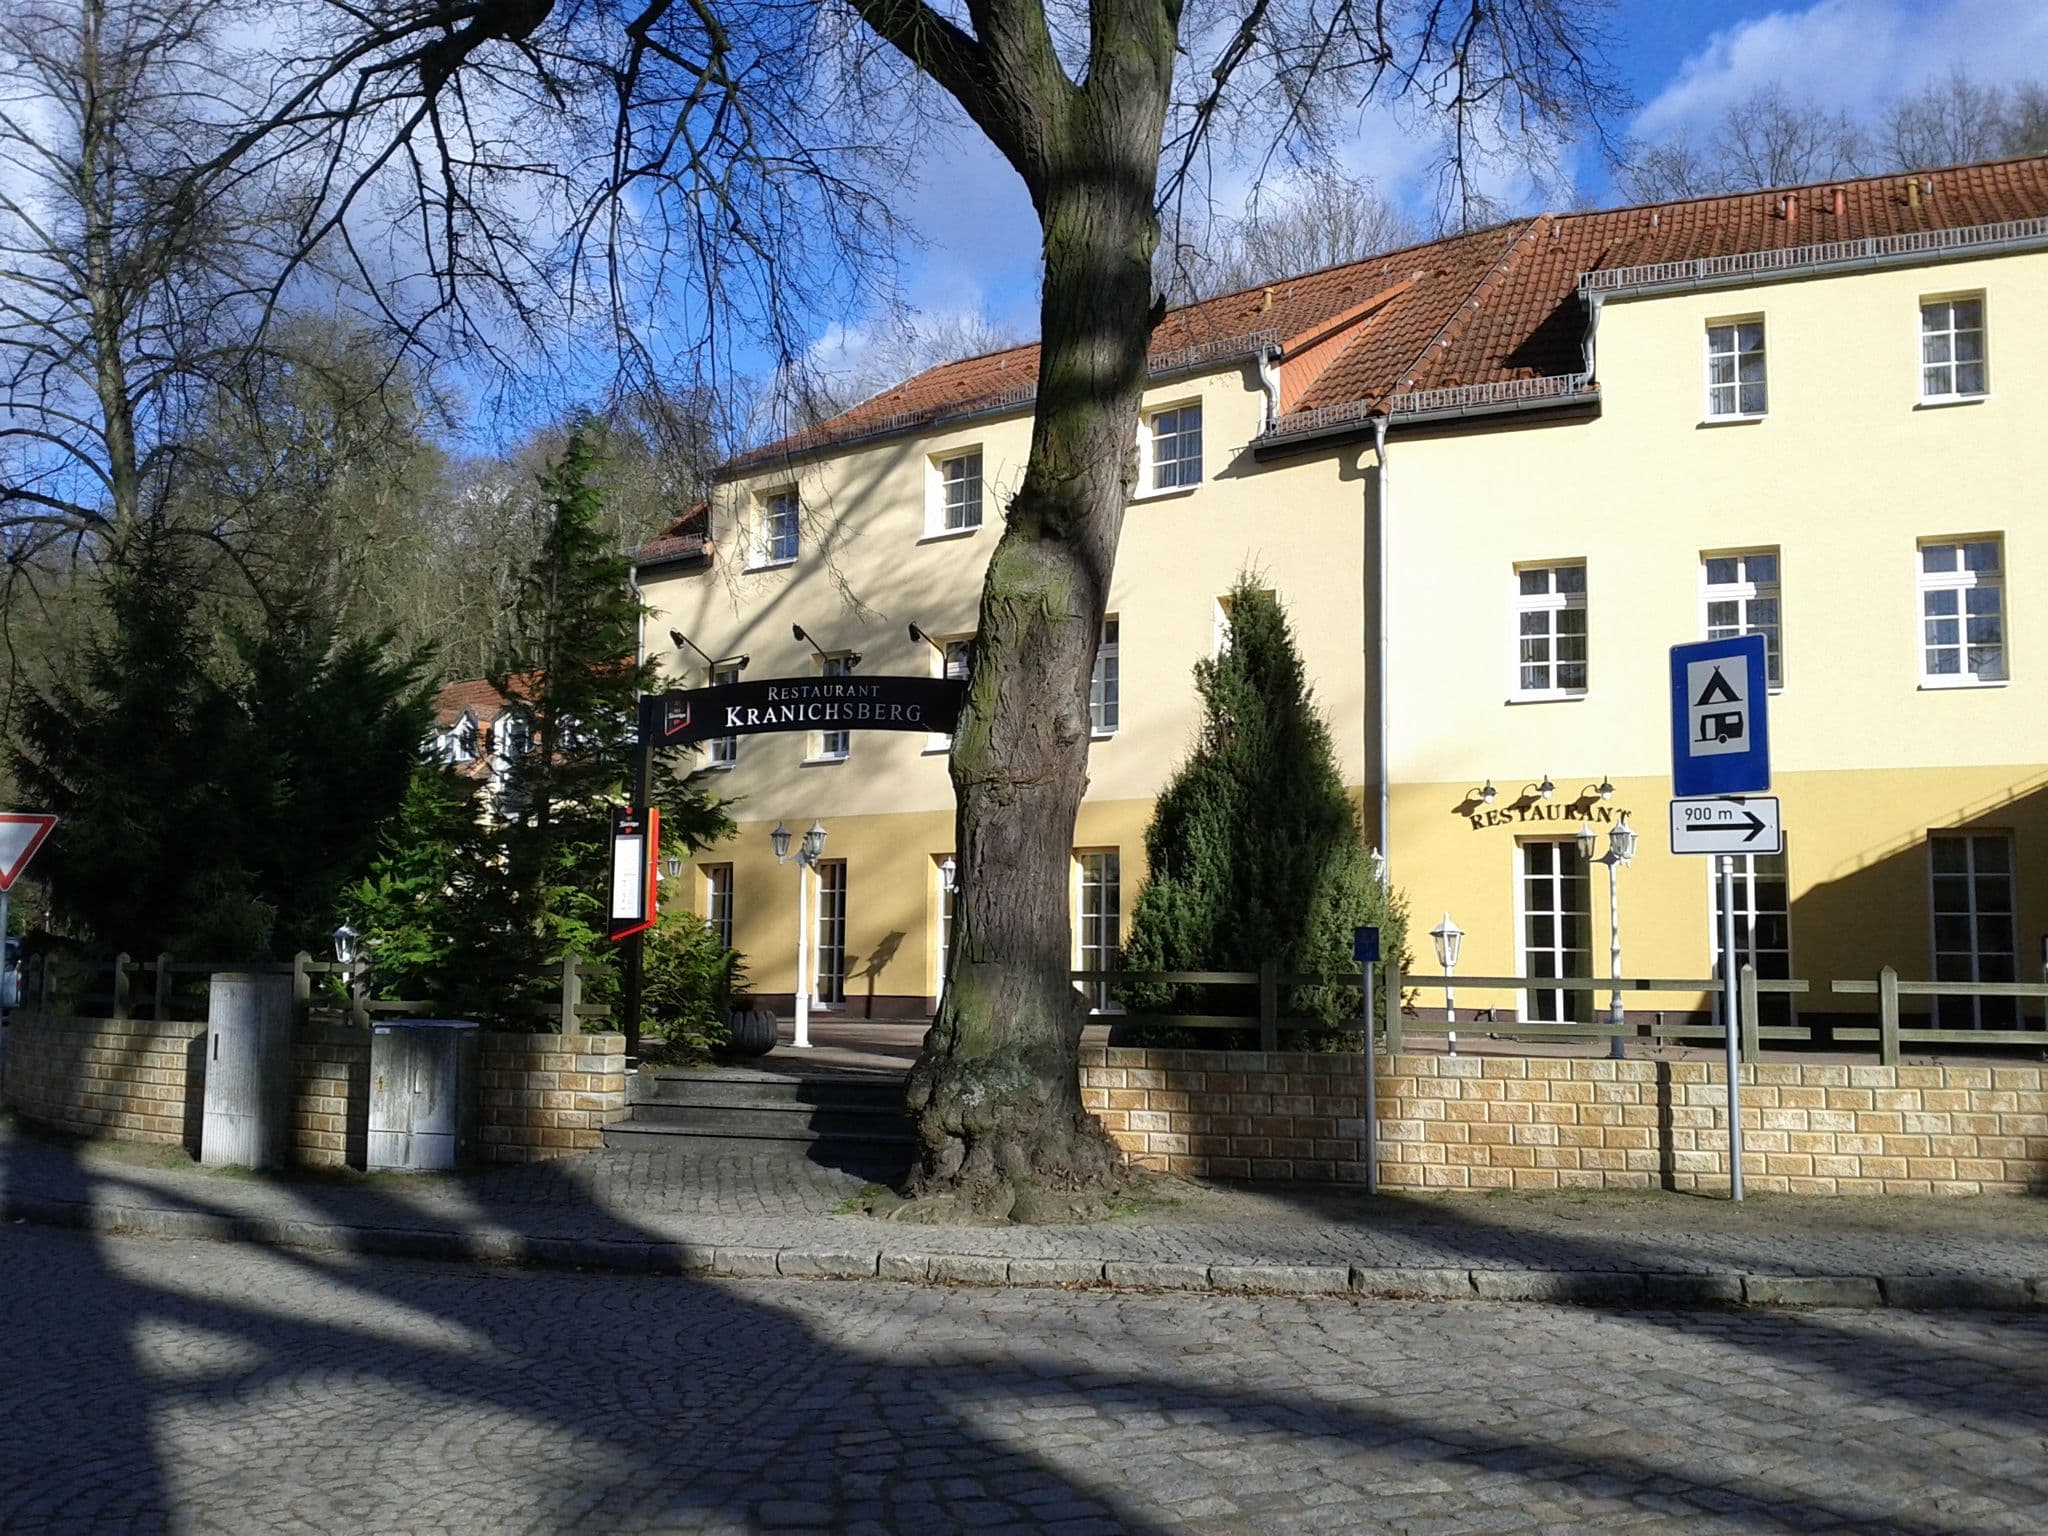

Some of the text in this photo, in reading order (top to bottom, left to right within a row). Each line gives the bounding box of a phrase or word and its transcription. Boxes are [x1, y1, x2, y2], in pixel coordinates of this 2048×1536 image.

[768, 685, 880, 701] RESTAURANT
[726, 703, 921, 727] KRANICHSBERG
[1470, 804, 1632, 830] RESTAURANT
[1684, 807, 1733, 821] 900 m
